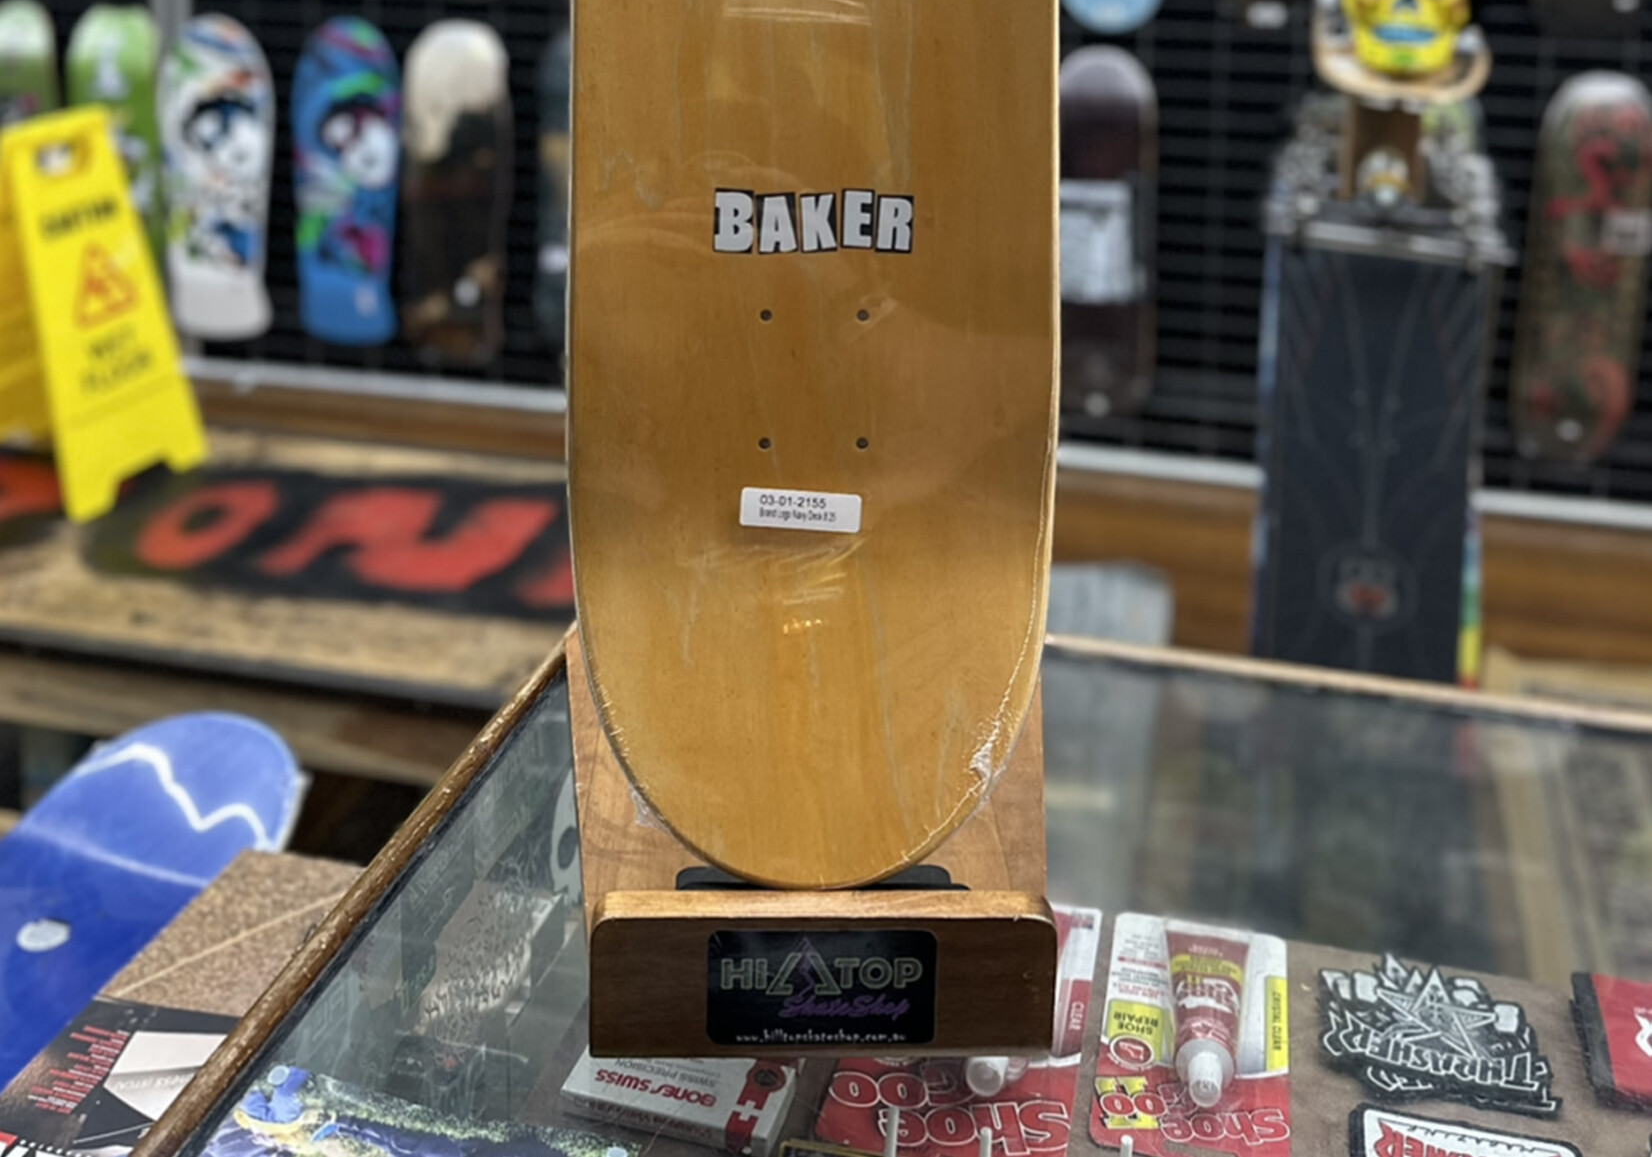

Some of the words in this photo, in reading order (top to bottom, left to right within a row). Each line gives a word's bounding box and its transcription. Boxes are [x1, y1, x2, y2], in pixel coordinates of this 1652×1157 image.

[713, 188, 914, 255] BAKER
[759, 494, 827, 509] 03-01-2155
[1113, 1011, 1160, 1028] REPAIR
[1116, 1021, 1154, 1035] SHOE
[1339, 1010, 1539, 1091] THRASHER
[595, 1069, 652, 1092] SWISS
[614, 1059, 678, 1081] PRECISION
[679, 1071, 716, 1088] SWISS
[650, 1084, 717, 1107] BONES
[1159, 1108, 1290, 1146] Shoe
[1404, 1123, 1536, 1155] MAGAZINE
